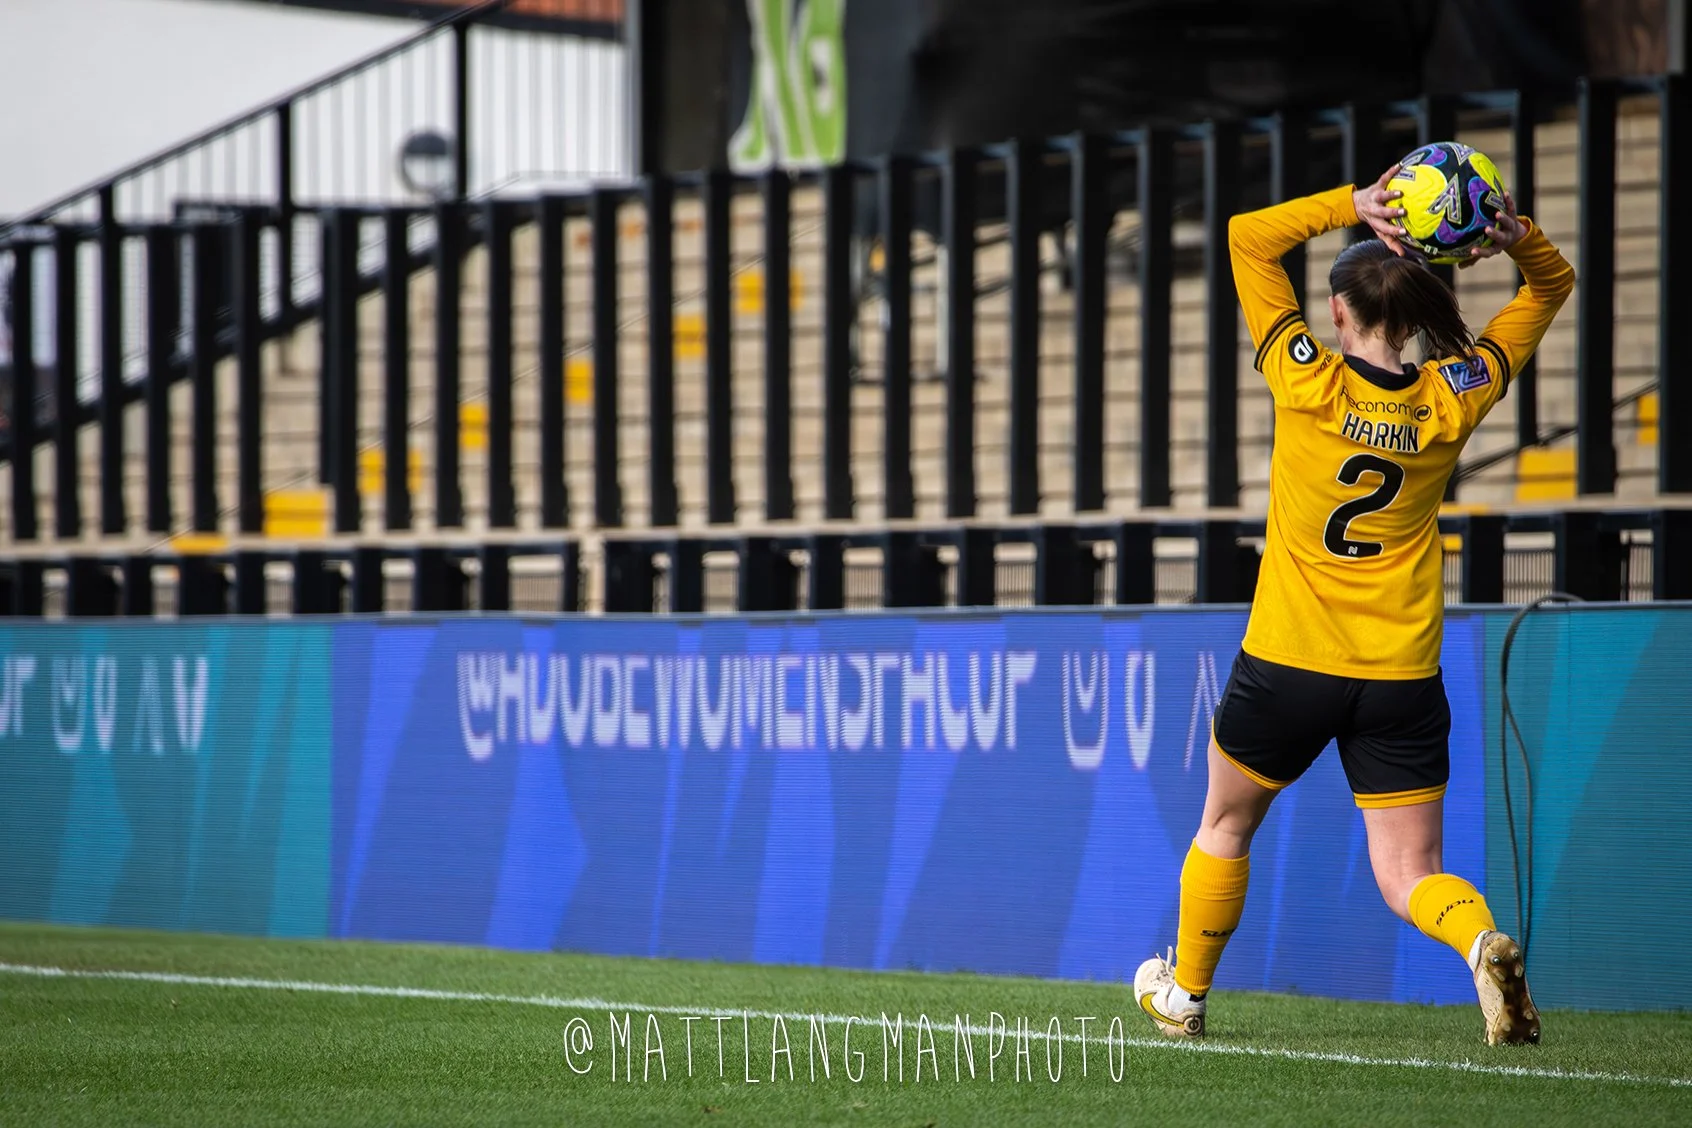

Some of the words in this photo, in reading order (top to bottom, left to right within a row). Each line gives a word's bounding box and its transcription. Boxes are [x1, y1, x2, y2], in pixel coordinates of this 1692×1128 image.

[1340, 384, 1414, 421] Reconom
[1341, 411, 1420, 453] HARKIN
[1323, 452, 1405, 559] 2
